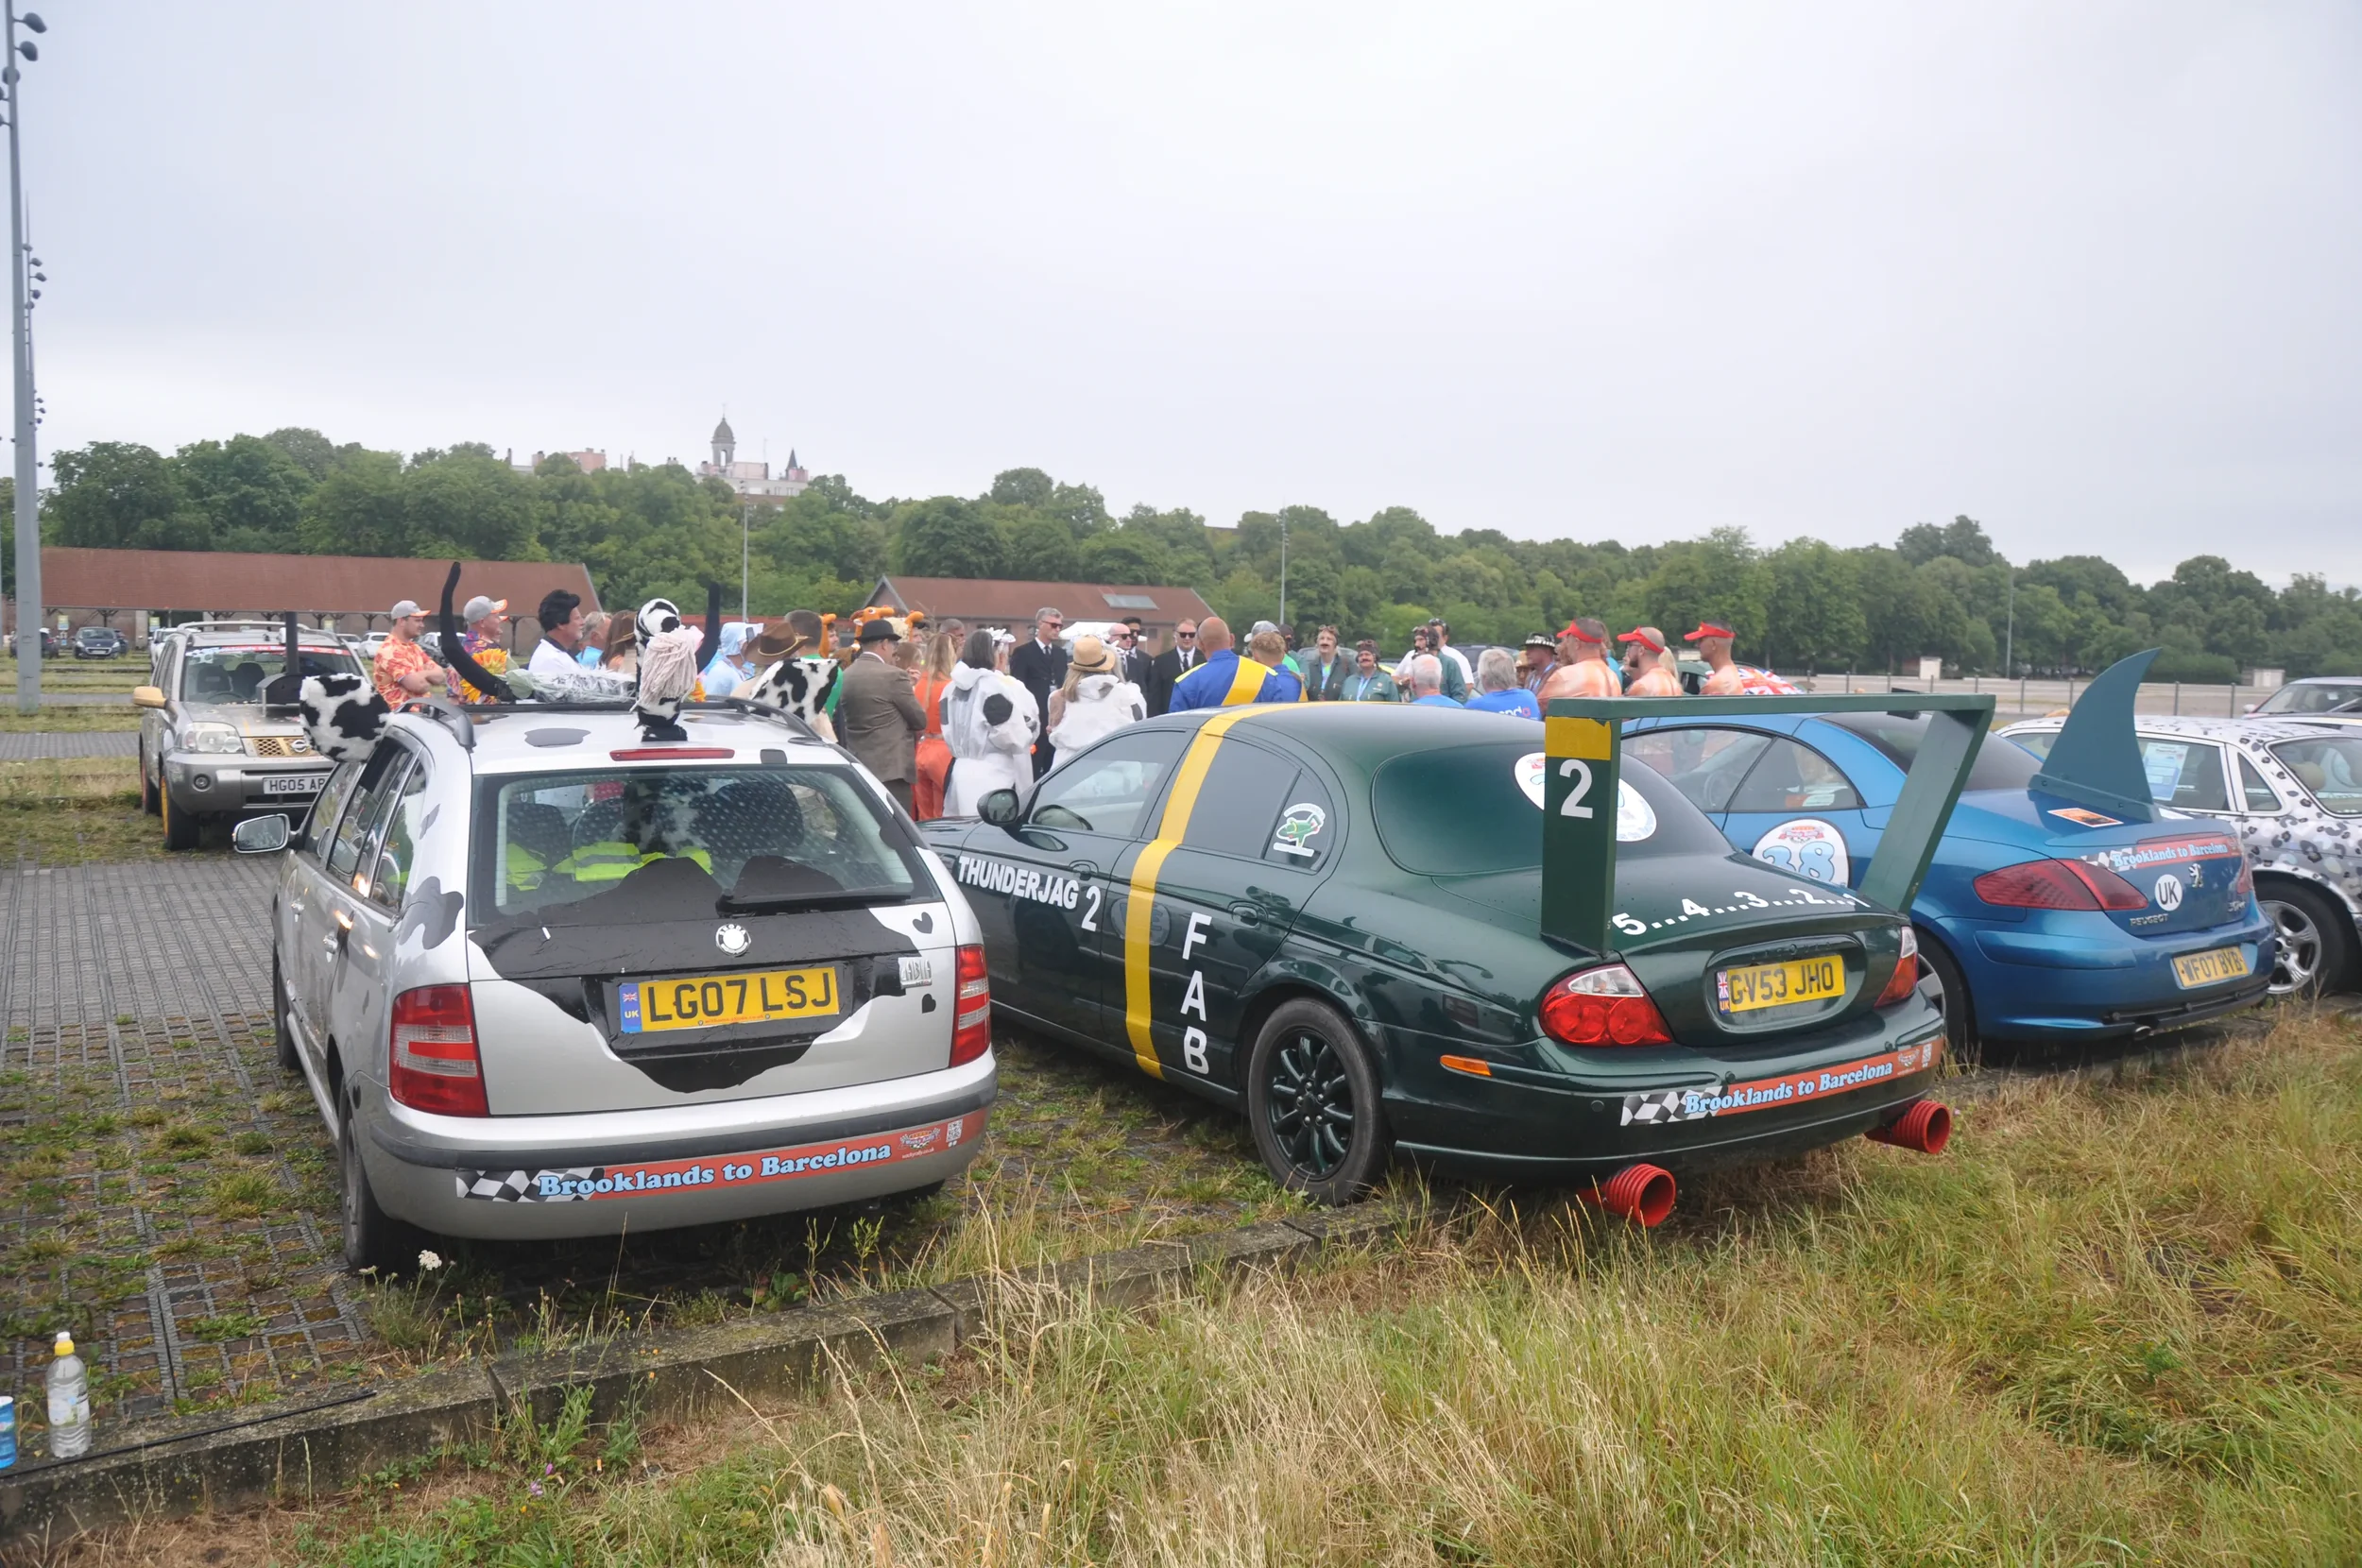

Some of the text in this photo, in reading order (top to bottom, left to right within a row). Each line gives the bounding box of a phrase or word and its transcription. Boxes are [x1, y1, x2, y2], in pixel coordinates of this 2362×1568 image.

[270, 779, 305, 792] HG05
[1560, 758, 1593, 818] 2
[2111, 846, 2177, 867] Brooklands
[2177, 845, 2188, 858] to
[2188, 844, 2228, 857] Barcelona
[958, 856, 1080, 910] THUNDERJAG
[1082, 885, 1102, 932] 2
[2157, 880, 2179, 905] UK
[2130, 913, 2168, 926] PEUGEOT
[648, 972, 831, 1022] LG07 LSJ
[1730, 968, 1788, 1005] GV53
[625, 1010, 640, 1018] UK
[1720, 1001, 1730, 1011] UK
[1685, 1062, 1893, 1115] Brooklands to Barcelona
[538, 1144, 892, 1198] Brooklands to Barcelona
